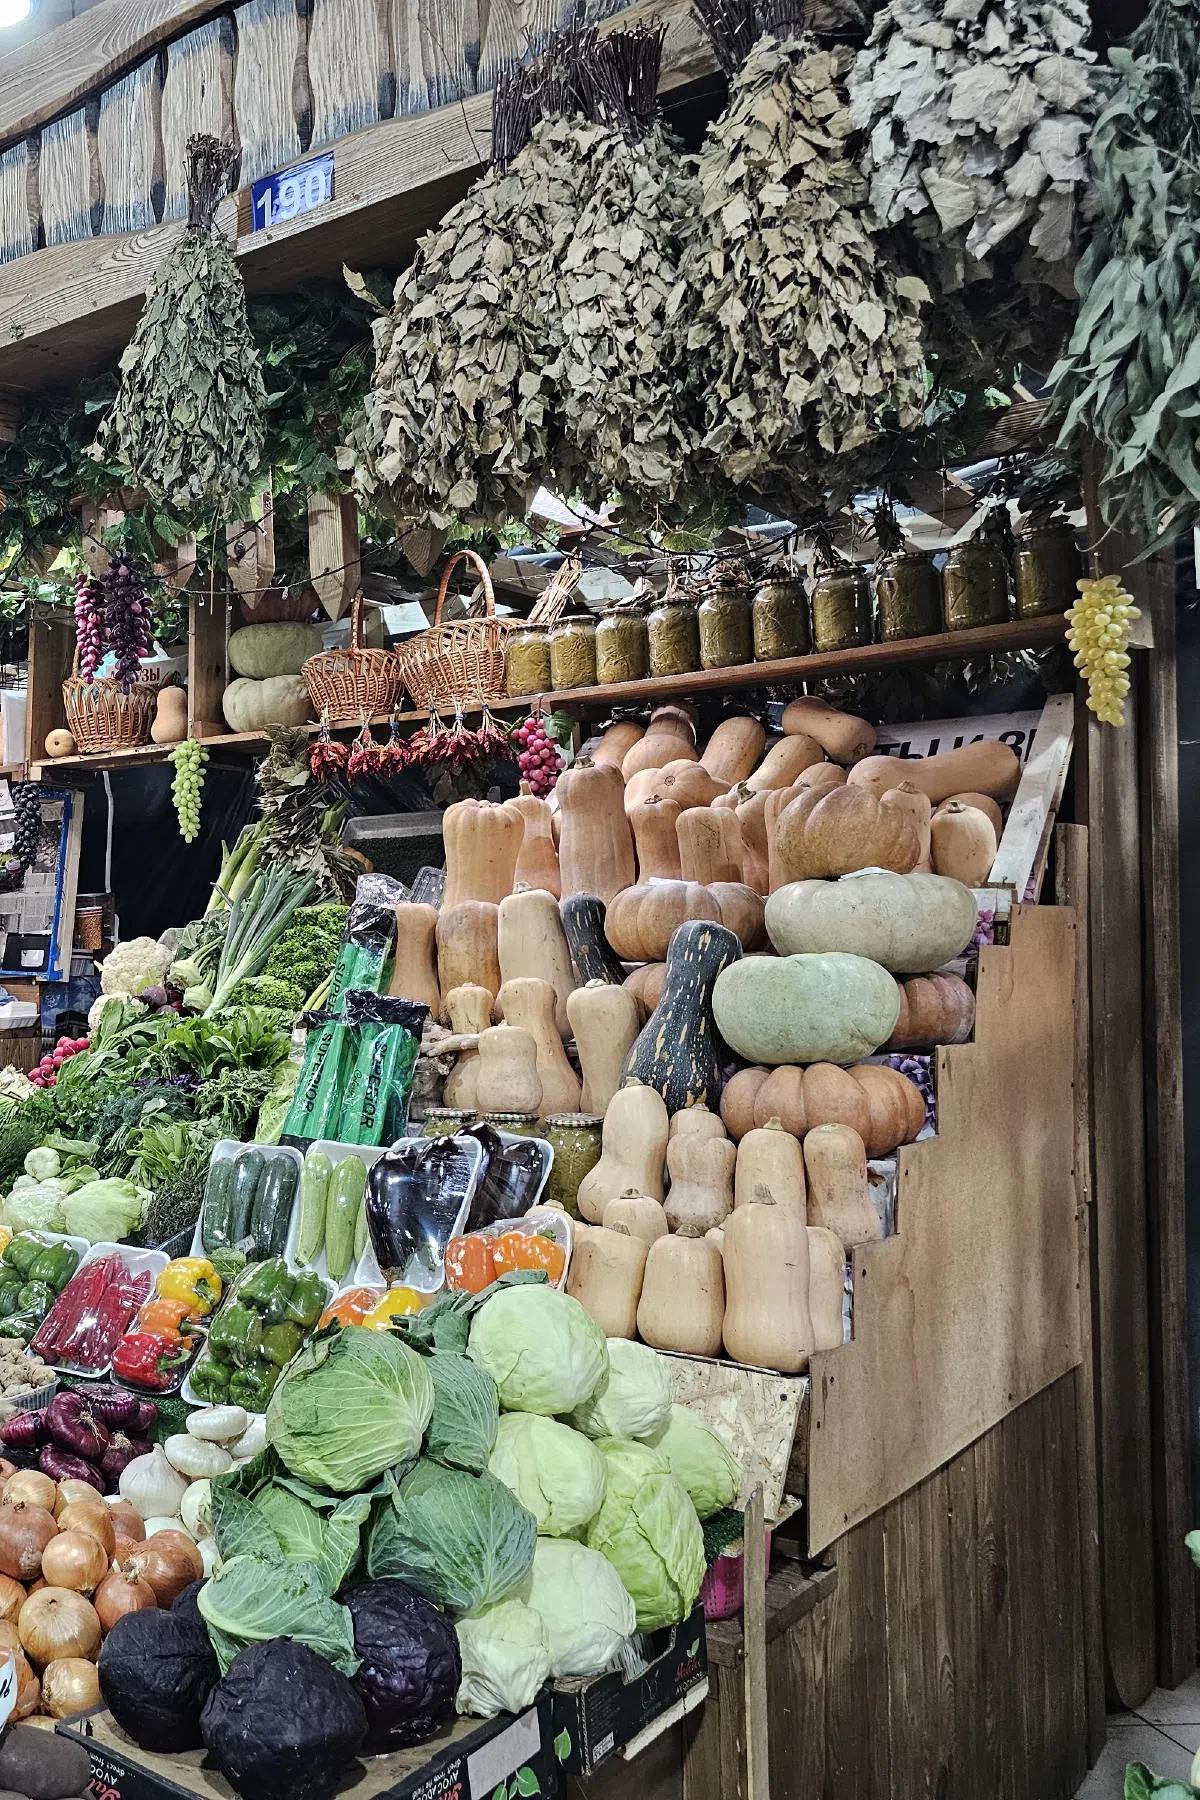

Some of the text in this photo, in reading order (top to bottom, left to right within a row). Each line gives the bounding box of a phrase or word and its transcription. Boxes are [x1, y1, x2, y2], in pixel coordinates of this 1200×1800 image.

[257, 169, 326, 228] 190
[327, 961, 346, 1013] SUPER
[88, 1777, 121, 1800] Gal
[91, 1765, 118, 1786] AVOC
[420, 1769, 459, 1800] AVOCADO
